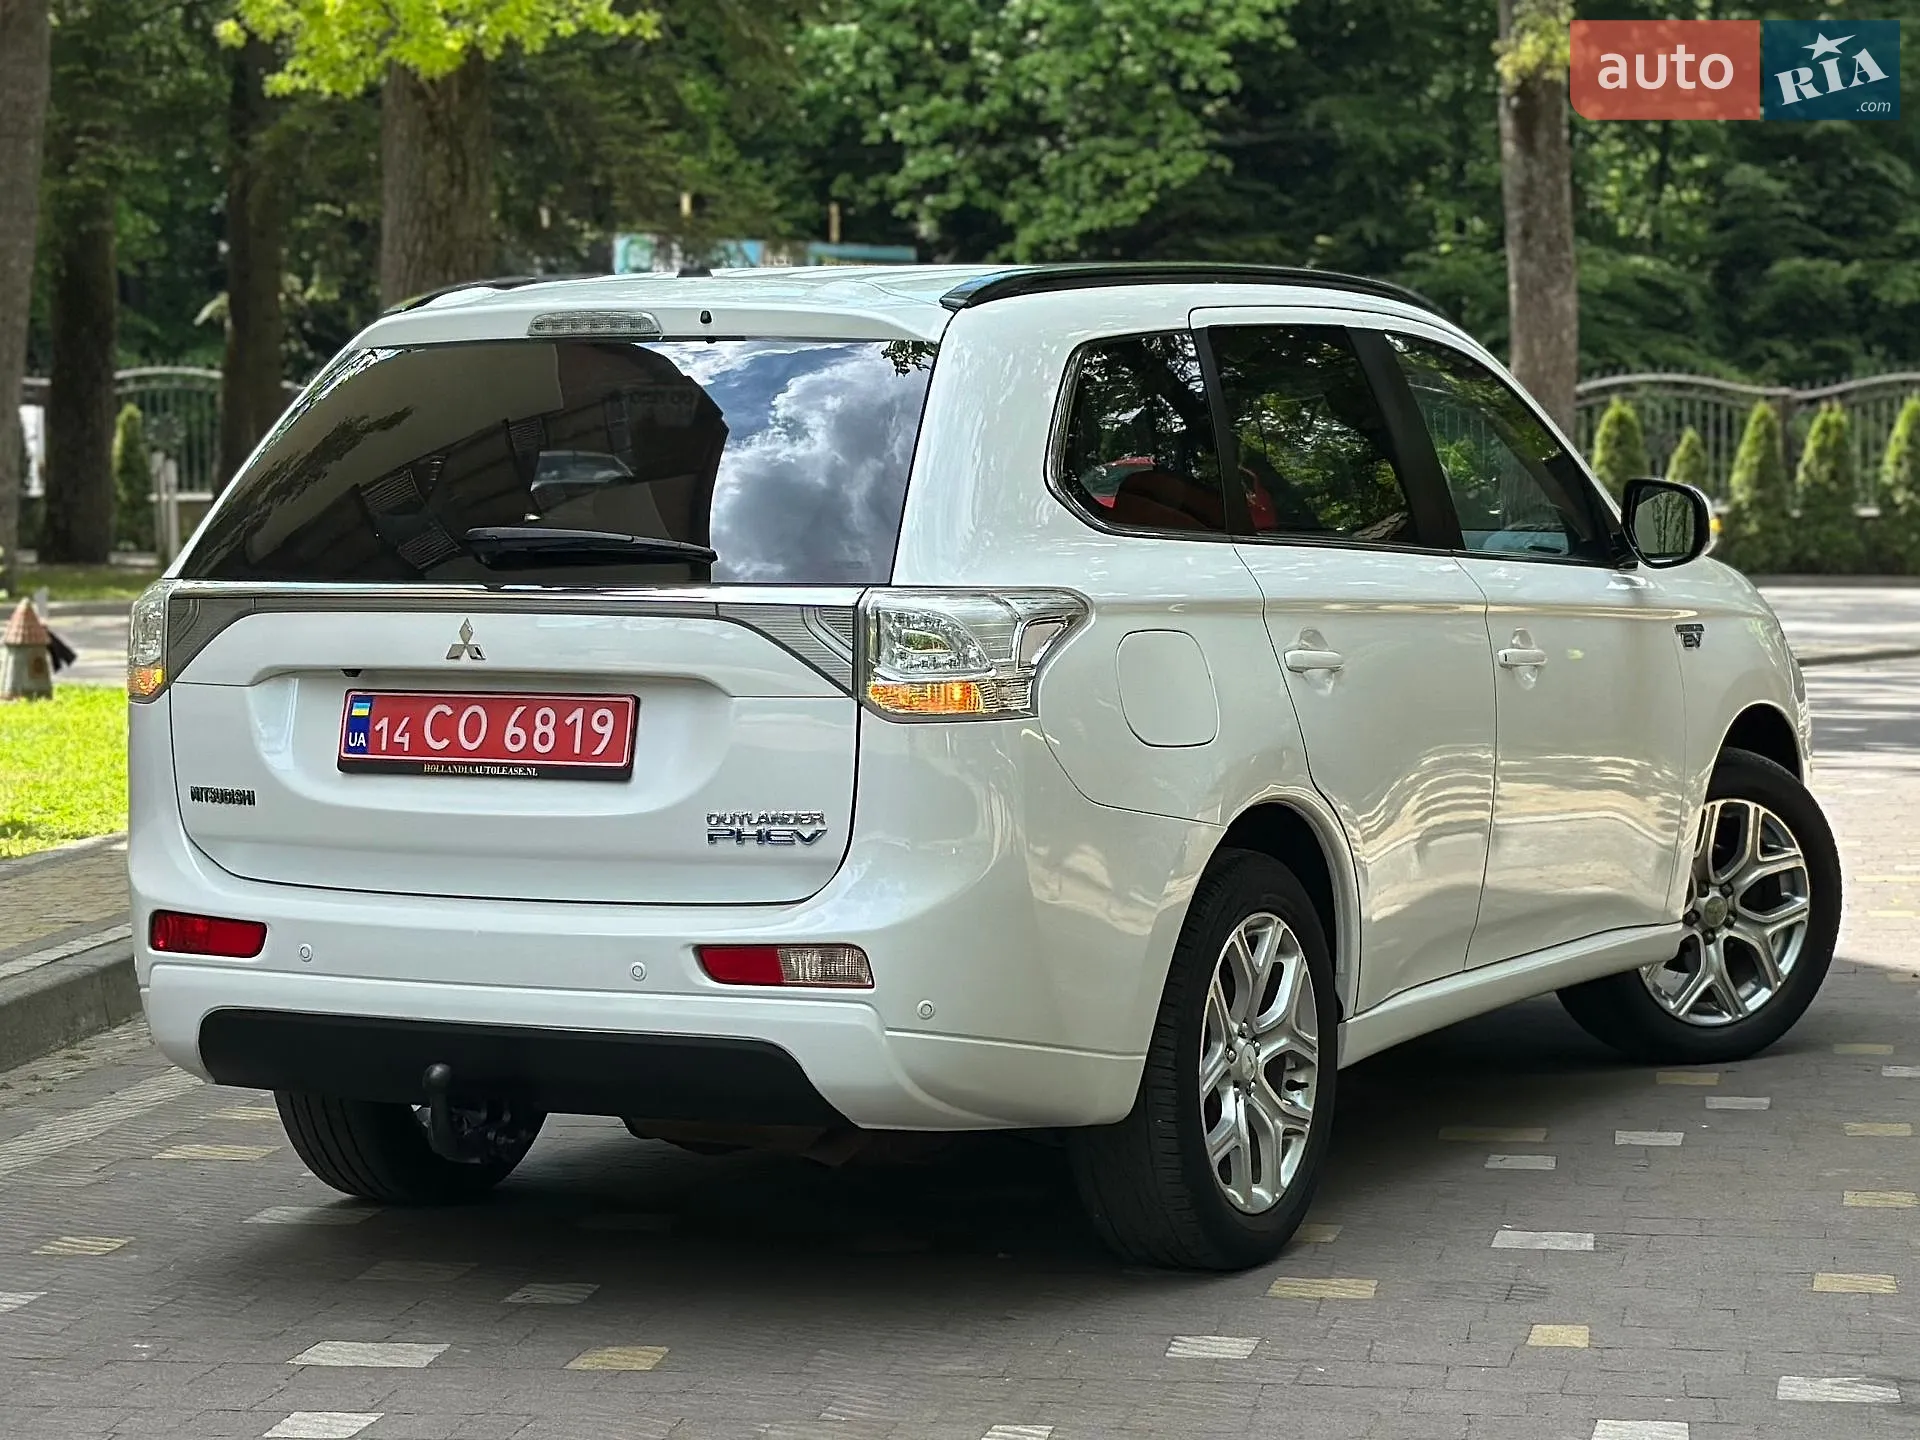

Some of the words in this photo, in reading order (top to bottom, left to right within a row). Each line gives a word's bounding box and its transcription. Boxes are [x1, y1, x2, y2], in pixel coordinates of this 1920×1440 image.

[374, 716, 411, 752] 14
[423, 703, 489, 751] CO
[503, 704, 616, 756] 6819
[348, 731, 367, 748] UA
[190, 785, 256, 807] MITSUBISHI
[706, 811, 825, 826] OUTLANDER
[707, 827, 828, 846] PHEV
